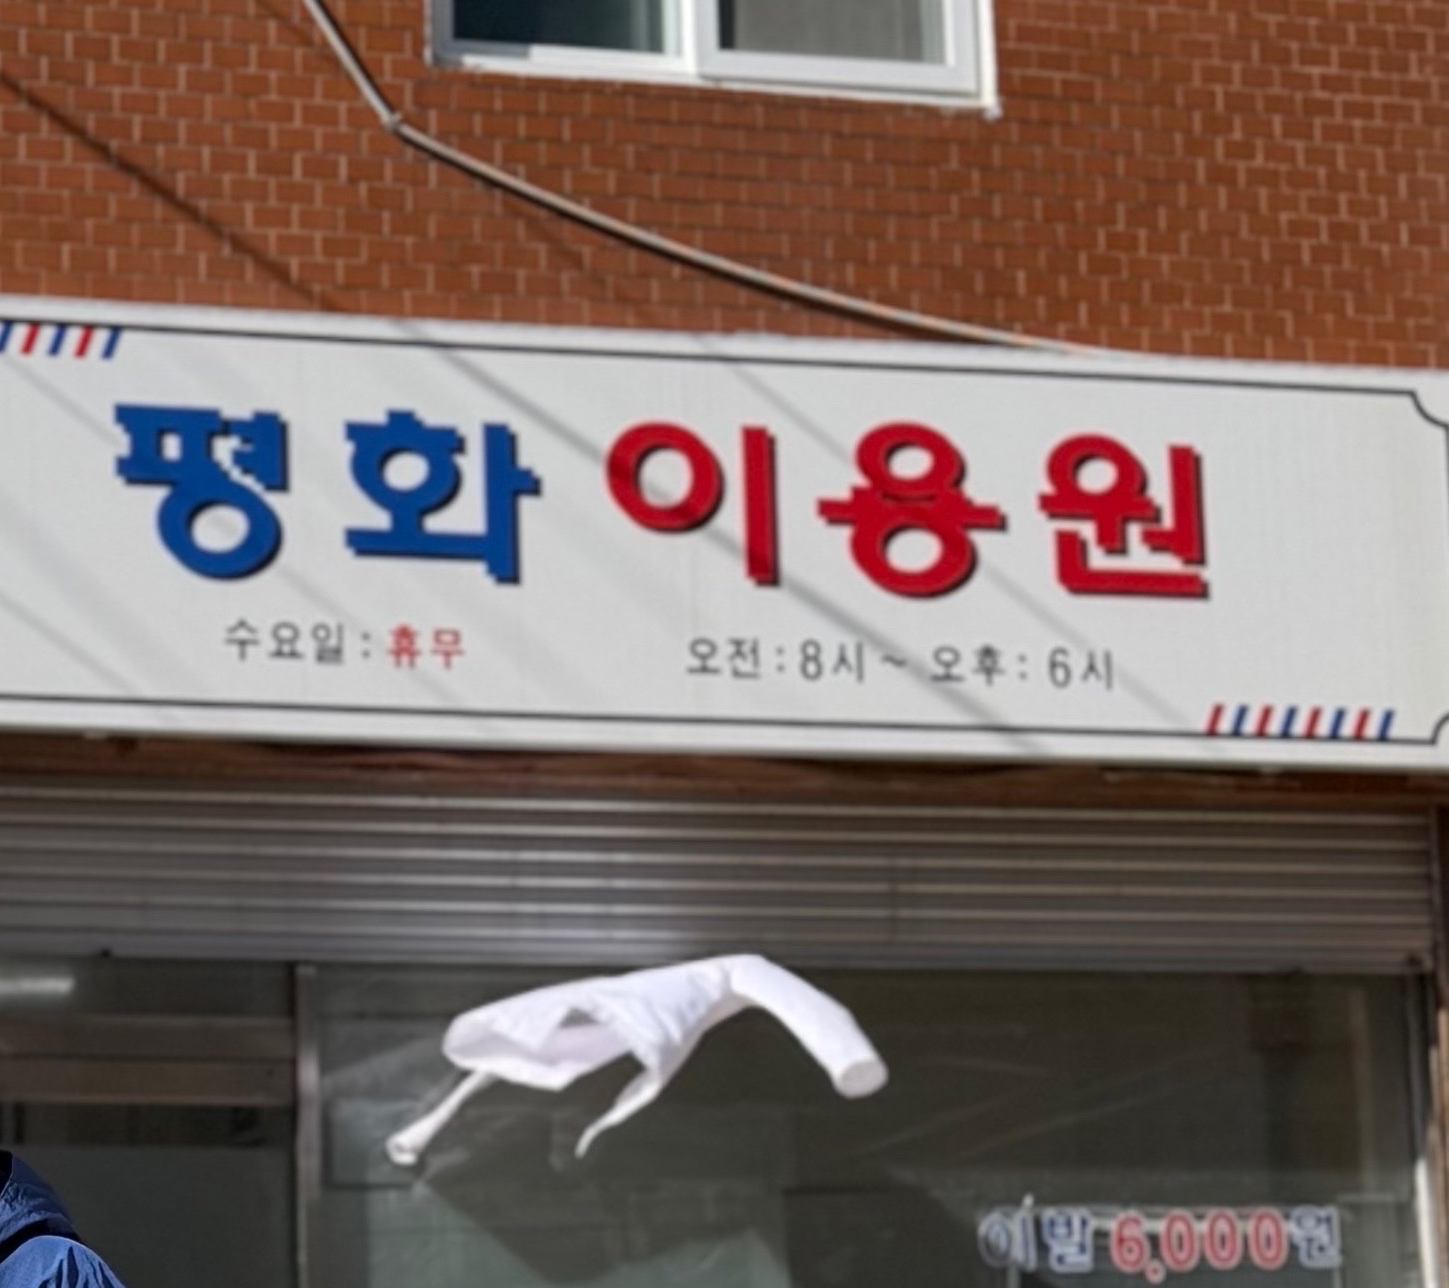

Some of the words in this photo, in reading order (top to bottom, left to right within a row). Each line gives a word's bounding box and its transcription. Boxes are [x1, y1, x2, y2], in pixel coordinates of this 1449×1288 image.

[114, 403, 542, 586] 평화
[605, 421, 1211, 600] 이용원
[387, 624, 467, 670] 휴무
